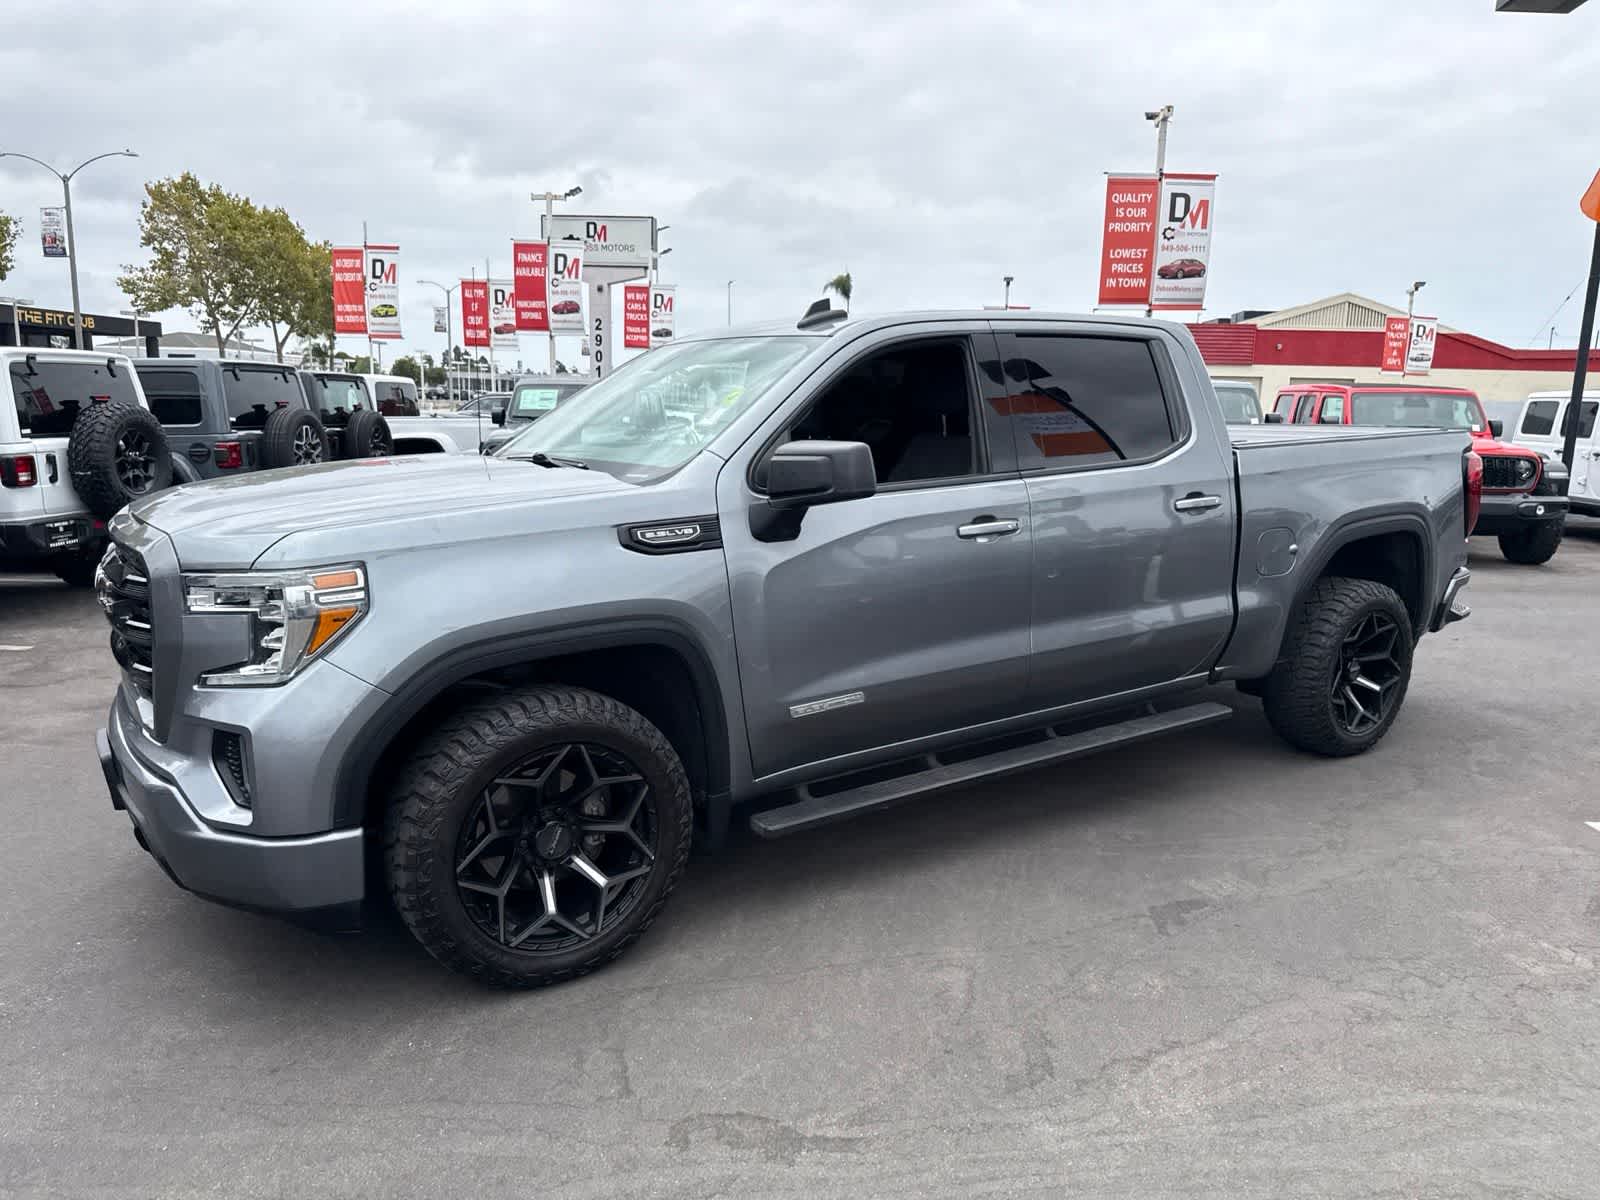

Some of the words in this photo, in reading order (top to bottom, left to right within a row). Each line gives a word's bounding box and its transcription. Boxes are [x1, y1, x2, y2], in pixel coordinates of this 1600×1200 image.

[1111, 193, 1152, 204] QUALITY
[1115, 207, 1125, 217] IS
[1126, 208, 1147, 217] OUR
[1108, 222, 1152, 233] PRIORITY
[600, 244, 635, 252] MOTORS
[517, 252, 543, 263] FINANCE
[1109, 248, 1148, 259] LOWEST
[515, 267, 545, 277] AVAILABLE
[1111, 263, 1144, 273] PRICES
[1105, 278, 1117, 288] IN
[1118, 278, 1146, 288] TOWN
[626, 292, 635, 300] WE
[635, 293, 647, 301] BUY
[626, 303, 641, 311] CARS
[16, 309, 43, 324] THE
[45, 311, 65, 325] FIT
[67, 314, 95, 329] CUB
[625, 312, 648, 321] TRUCKS
[1387, 331, 1407, 339] TRUCKS
